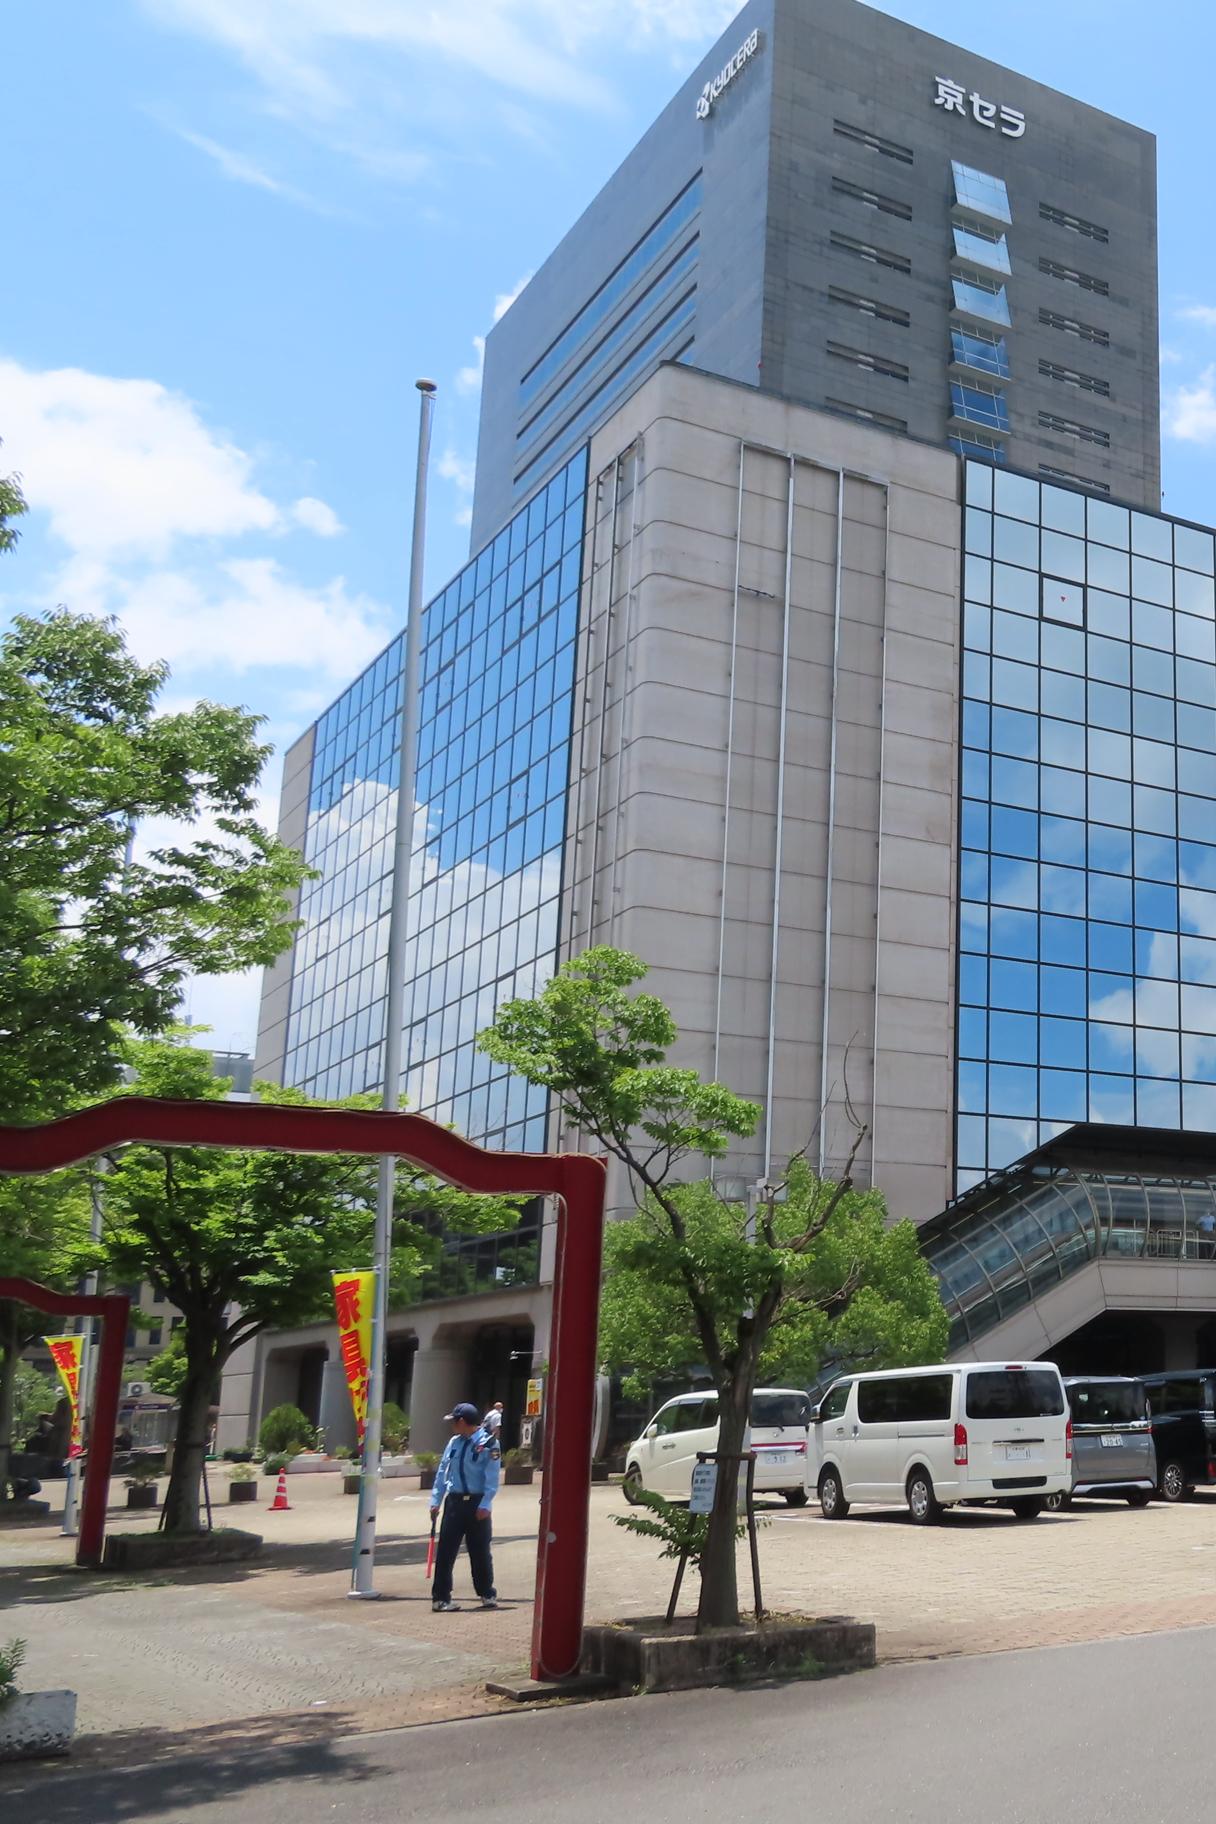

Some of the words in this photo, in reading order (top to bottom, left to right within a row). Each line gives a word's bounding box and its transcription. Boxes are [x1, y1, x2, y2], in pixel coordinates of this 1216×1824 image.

[709, 28, 761, 98] KYOCERA
[933, 74, 1026, 139] 京セラ
